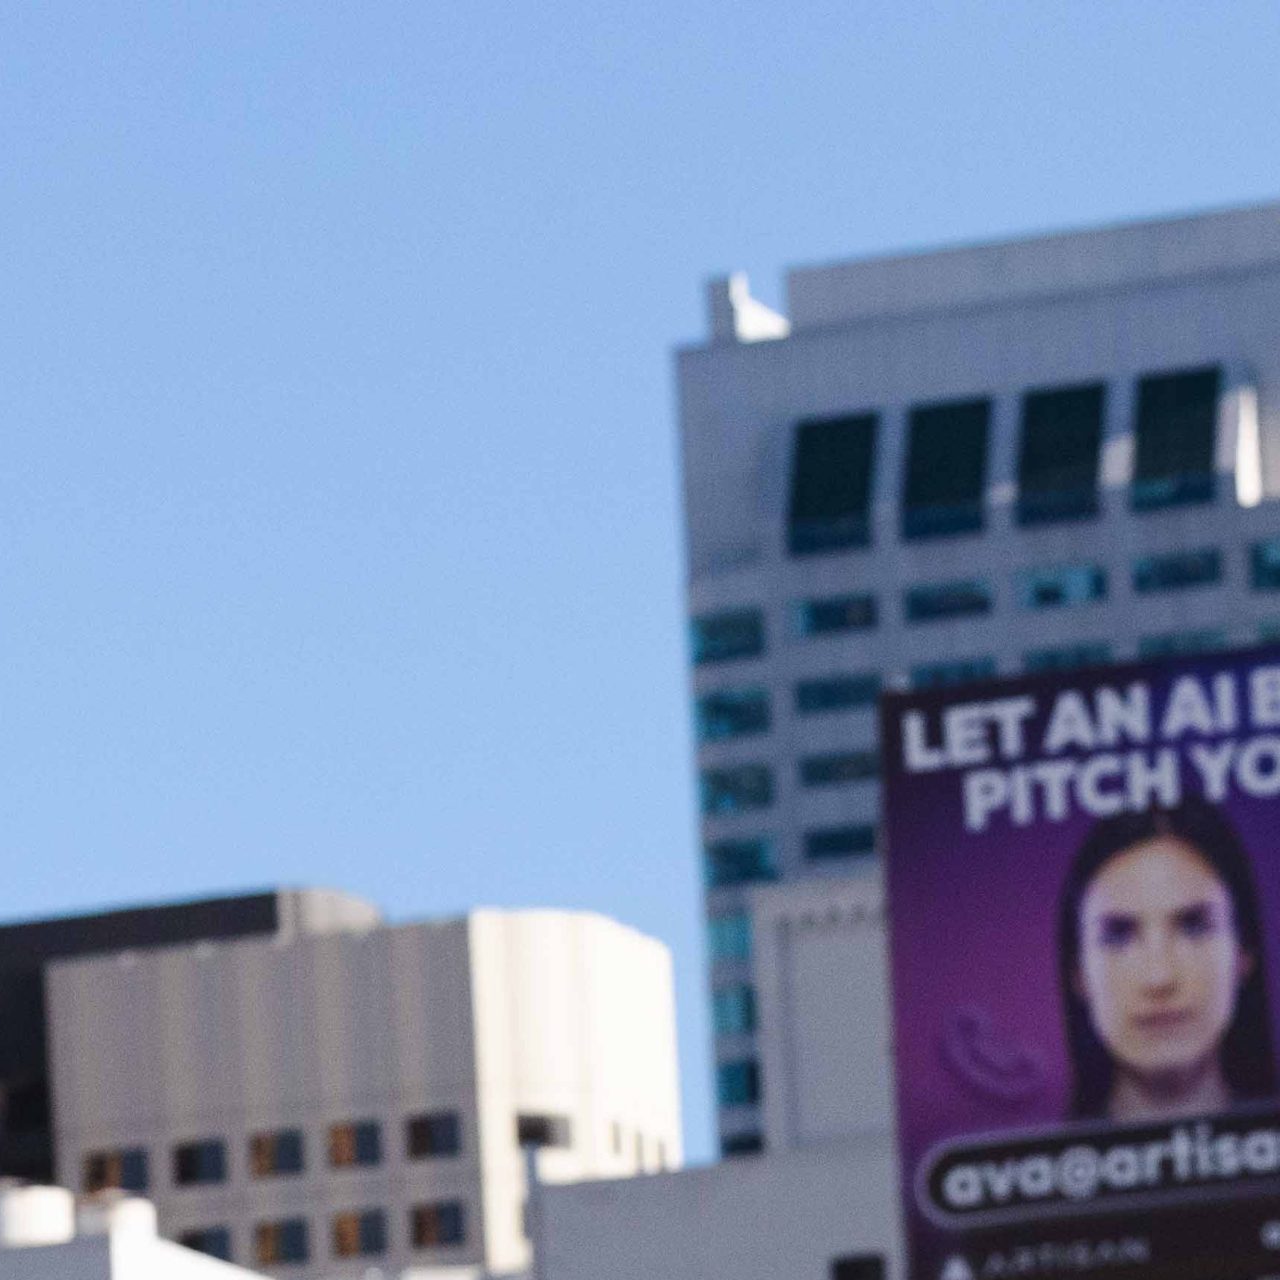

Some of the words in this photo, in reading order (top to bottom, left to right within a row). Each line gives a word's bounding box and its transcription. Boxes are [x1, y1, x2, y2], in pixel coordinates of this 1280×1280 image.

[900, 695, 1037, 774] LET
[1042, 681, 1151, 755] AN
[1159, 670, 1239, 739] AI
[962, 748, 1183, 833] PITCH
[1189, 737, 1280, 803] YO
